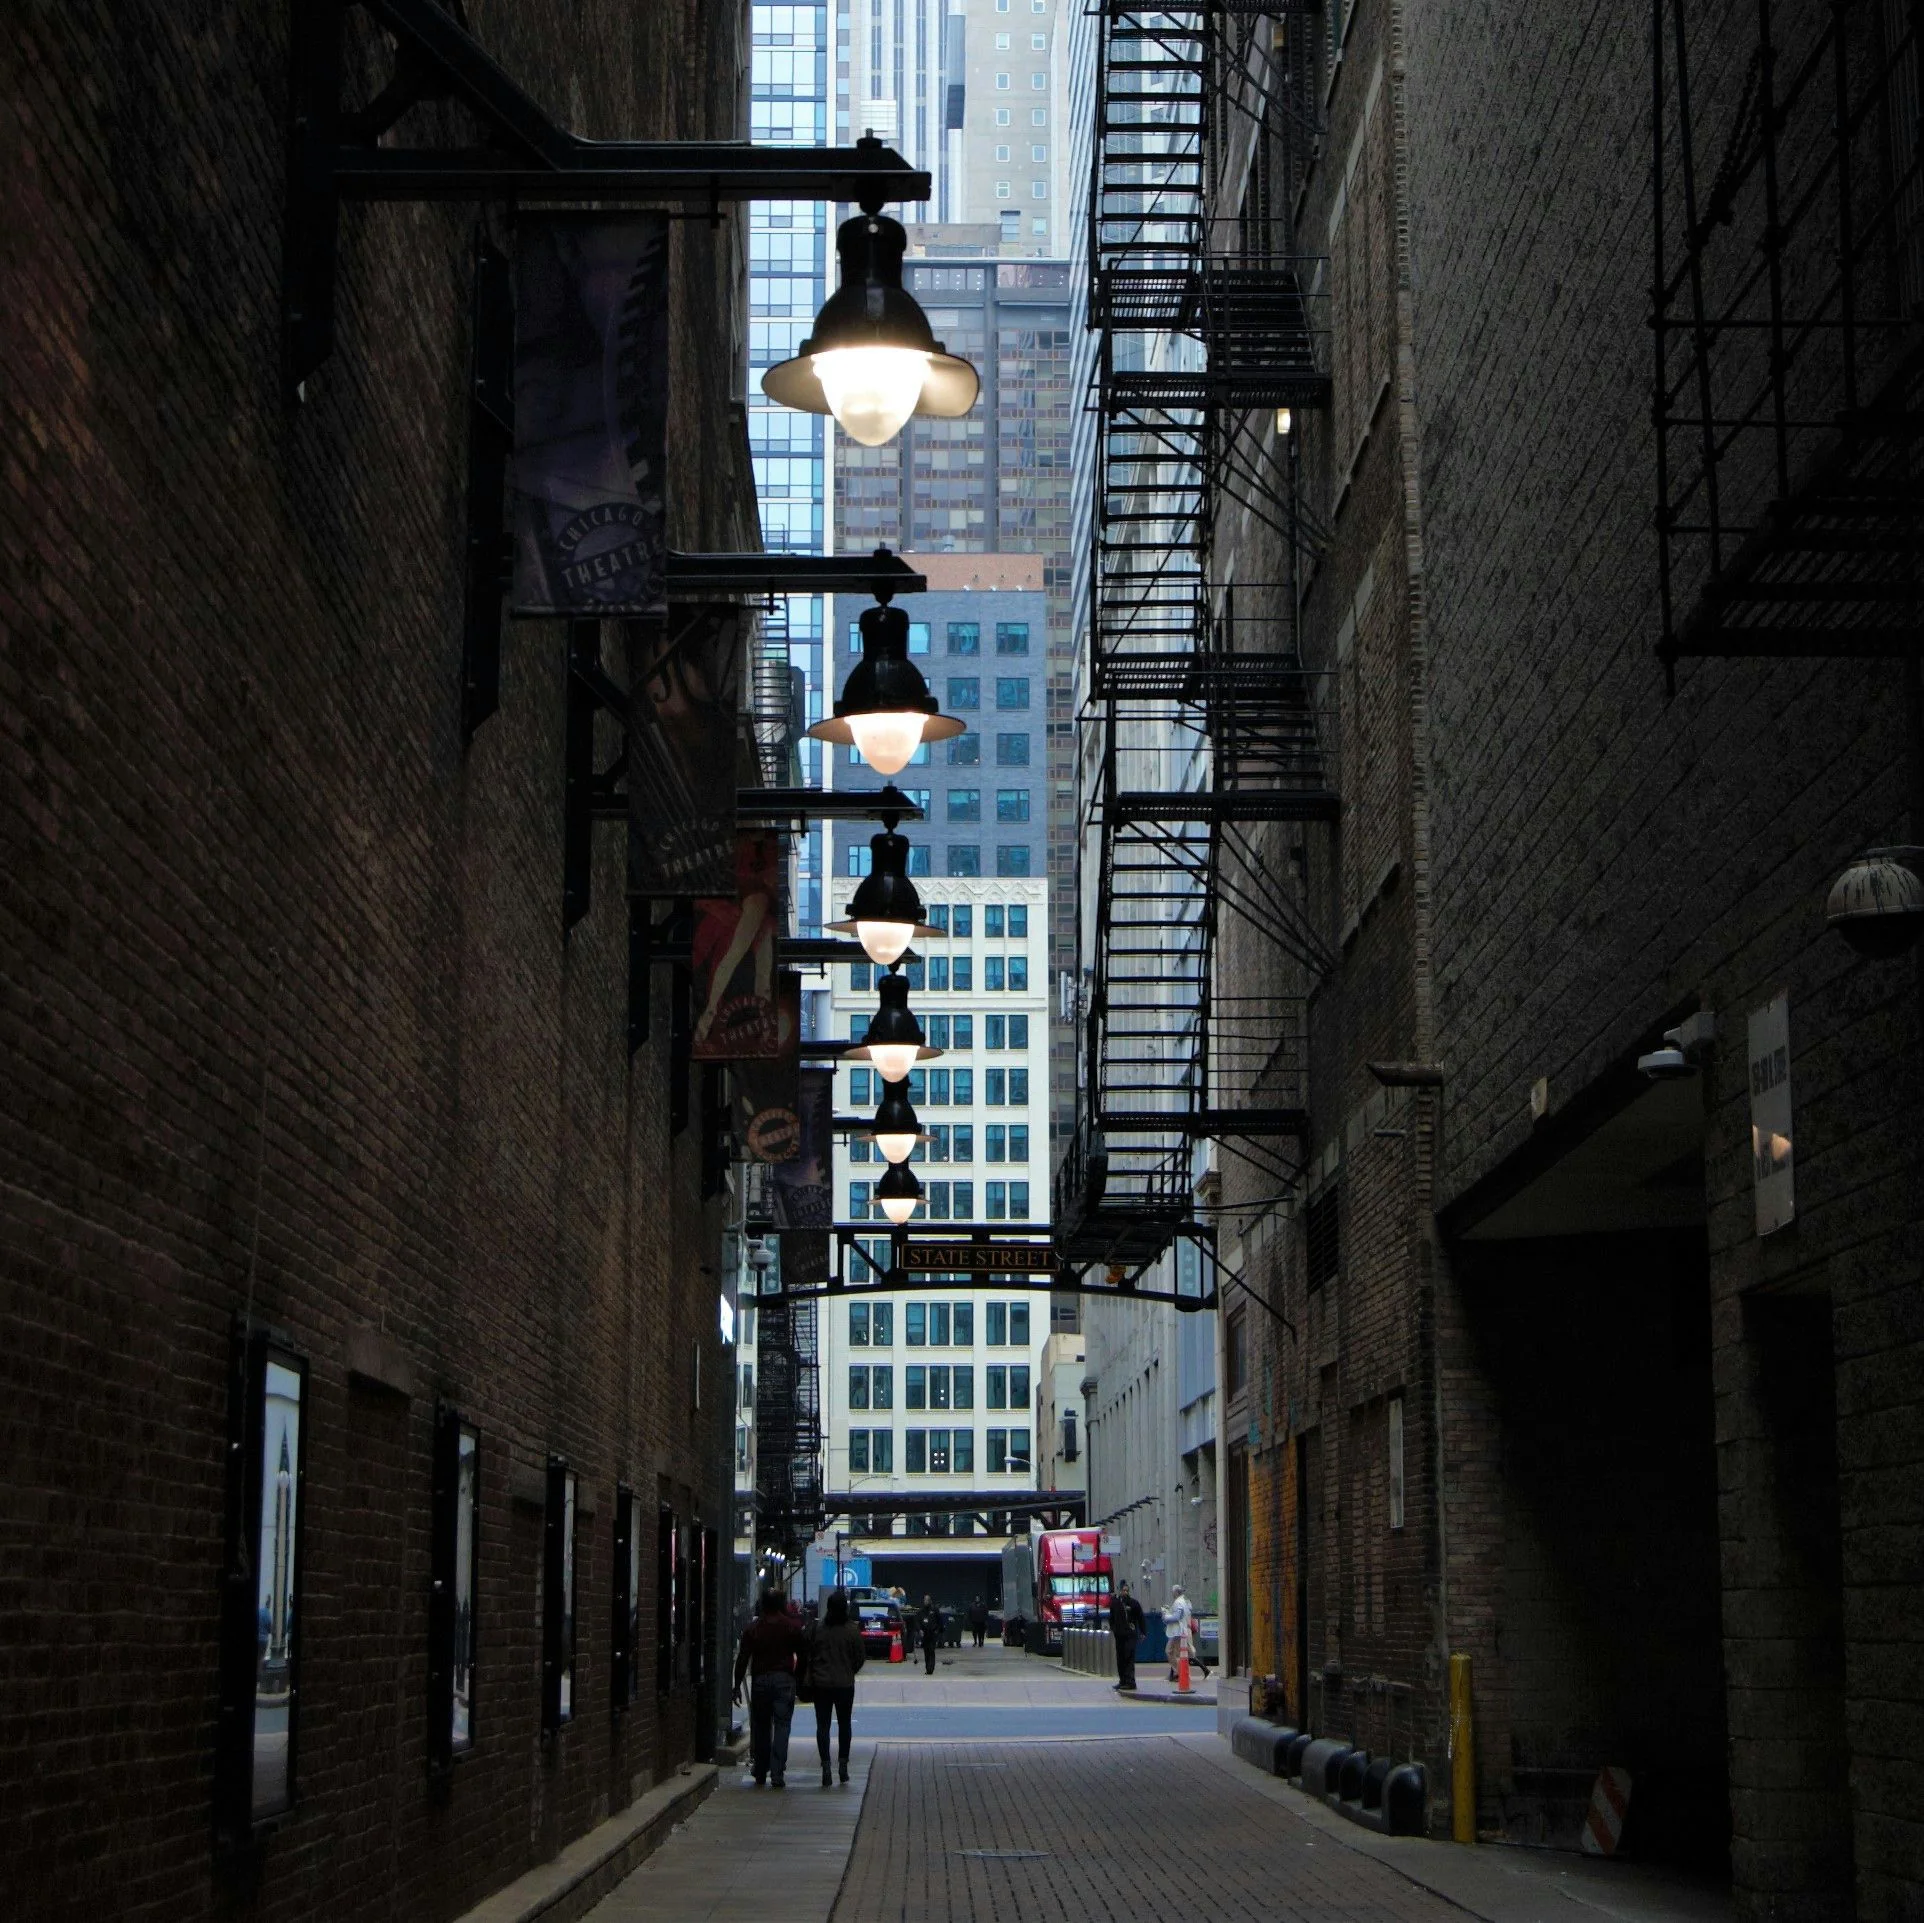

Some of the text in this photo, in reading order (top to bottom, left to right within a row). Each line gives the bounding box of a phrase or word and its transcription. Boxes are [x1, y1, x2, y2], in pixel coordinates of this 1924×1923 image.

[560, 506, 644, 551] CHICAGO
[910, 1250, 1050, 1266] STATE STREET
